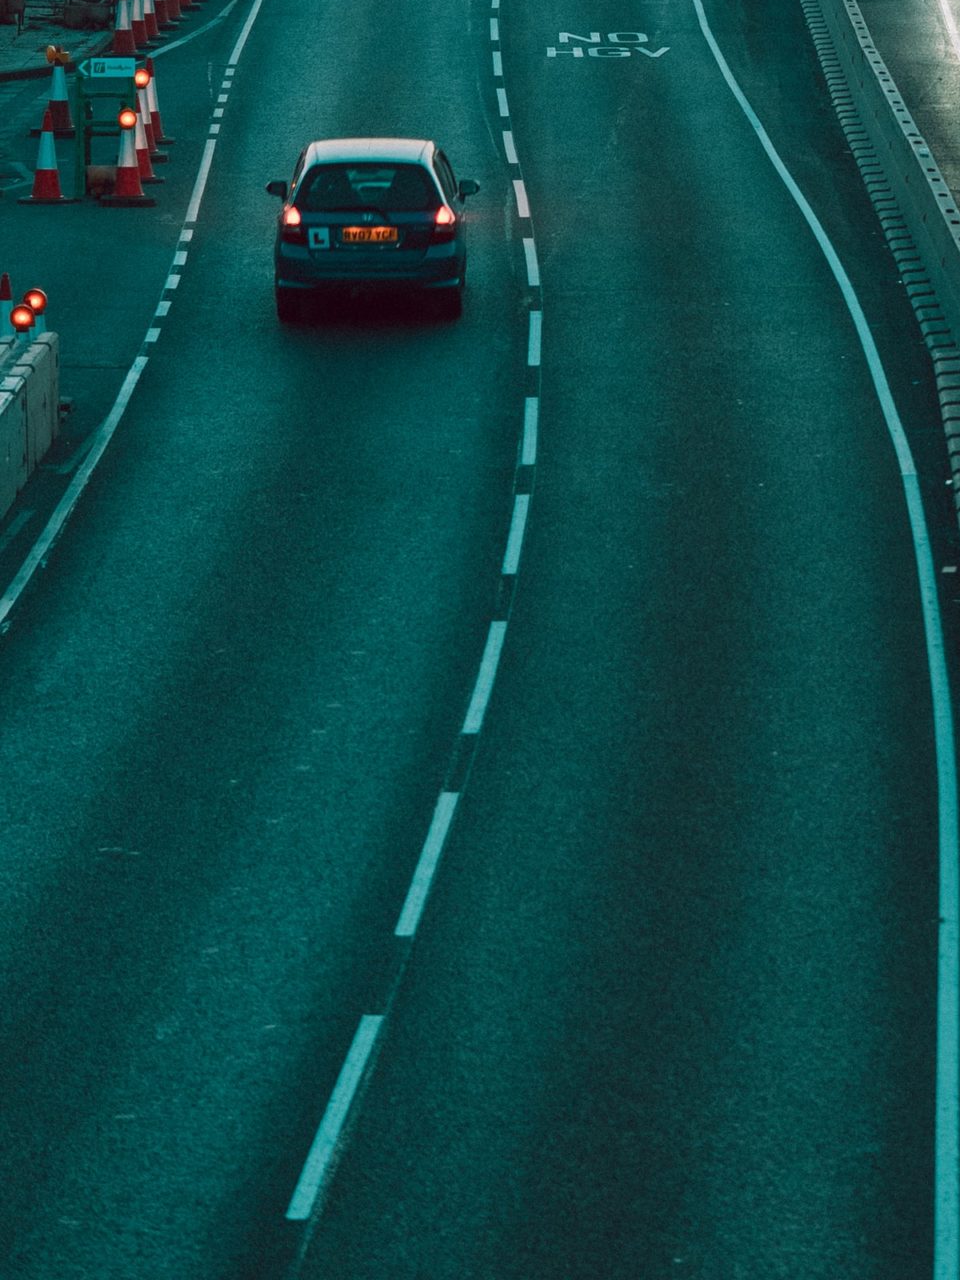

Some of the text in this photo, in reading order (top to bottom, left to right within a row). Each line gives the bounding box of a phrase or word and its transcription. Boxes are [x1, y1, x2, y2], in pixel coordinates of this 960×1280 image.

[559, 32, 649, 43] NO
[546, 47, 671, 58] HGV
[314, 233, 325, 244] L
